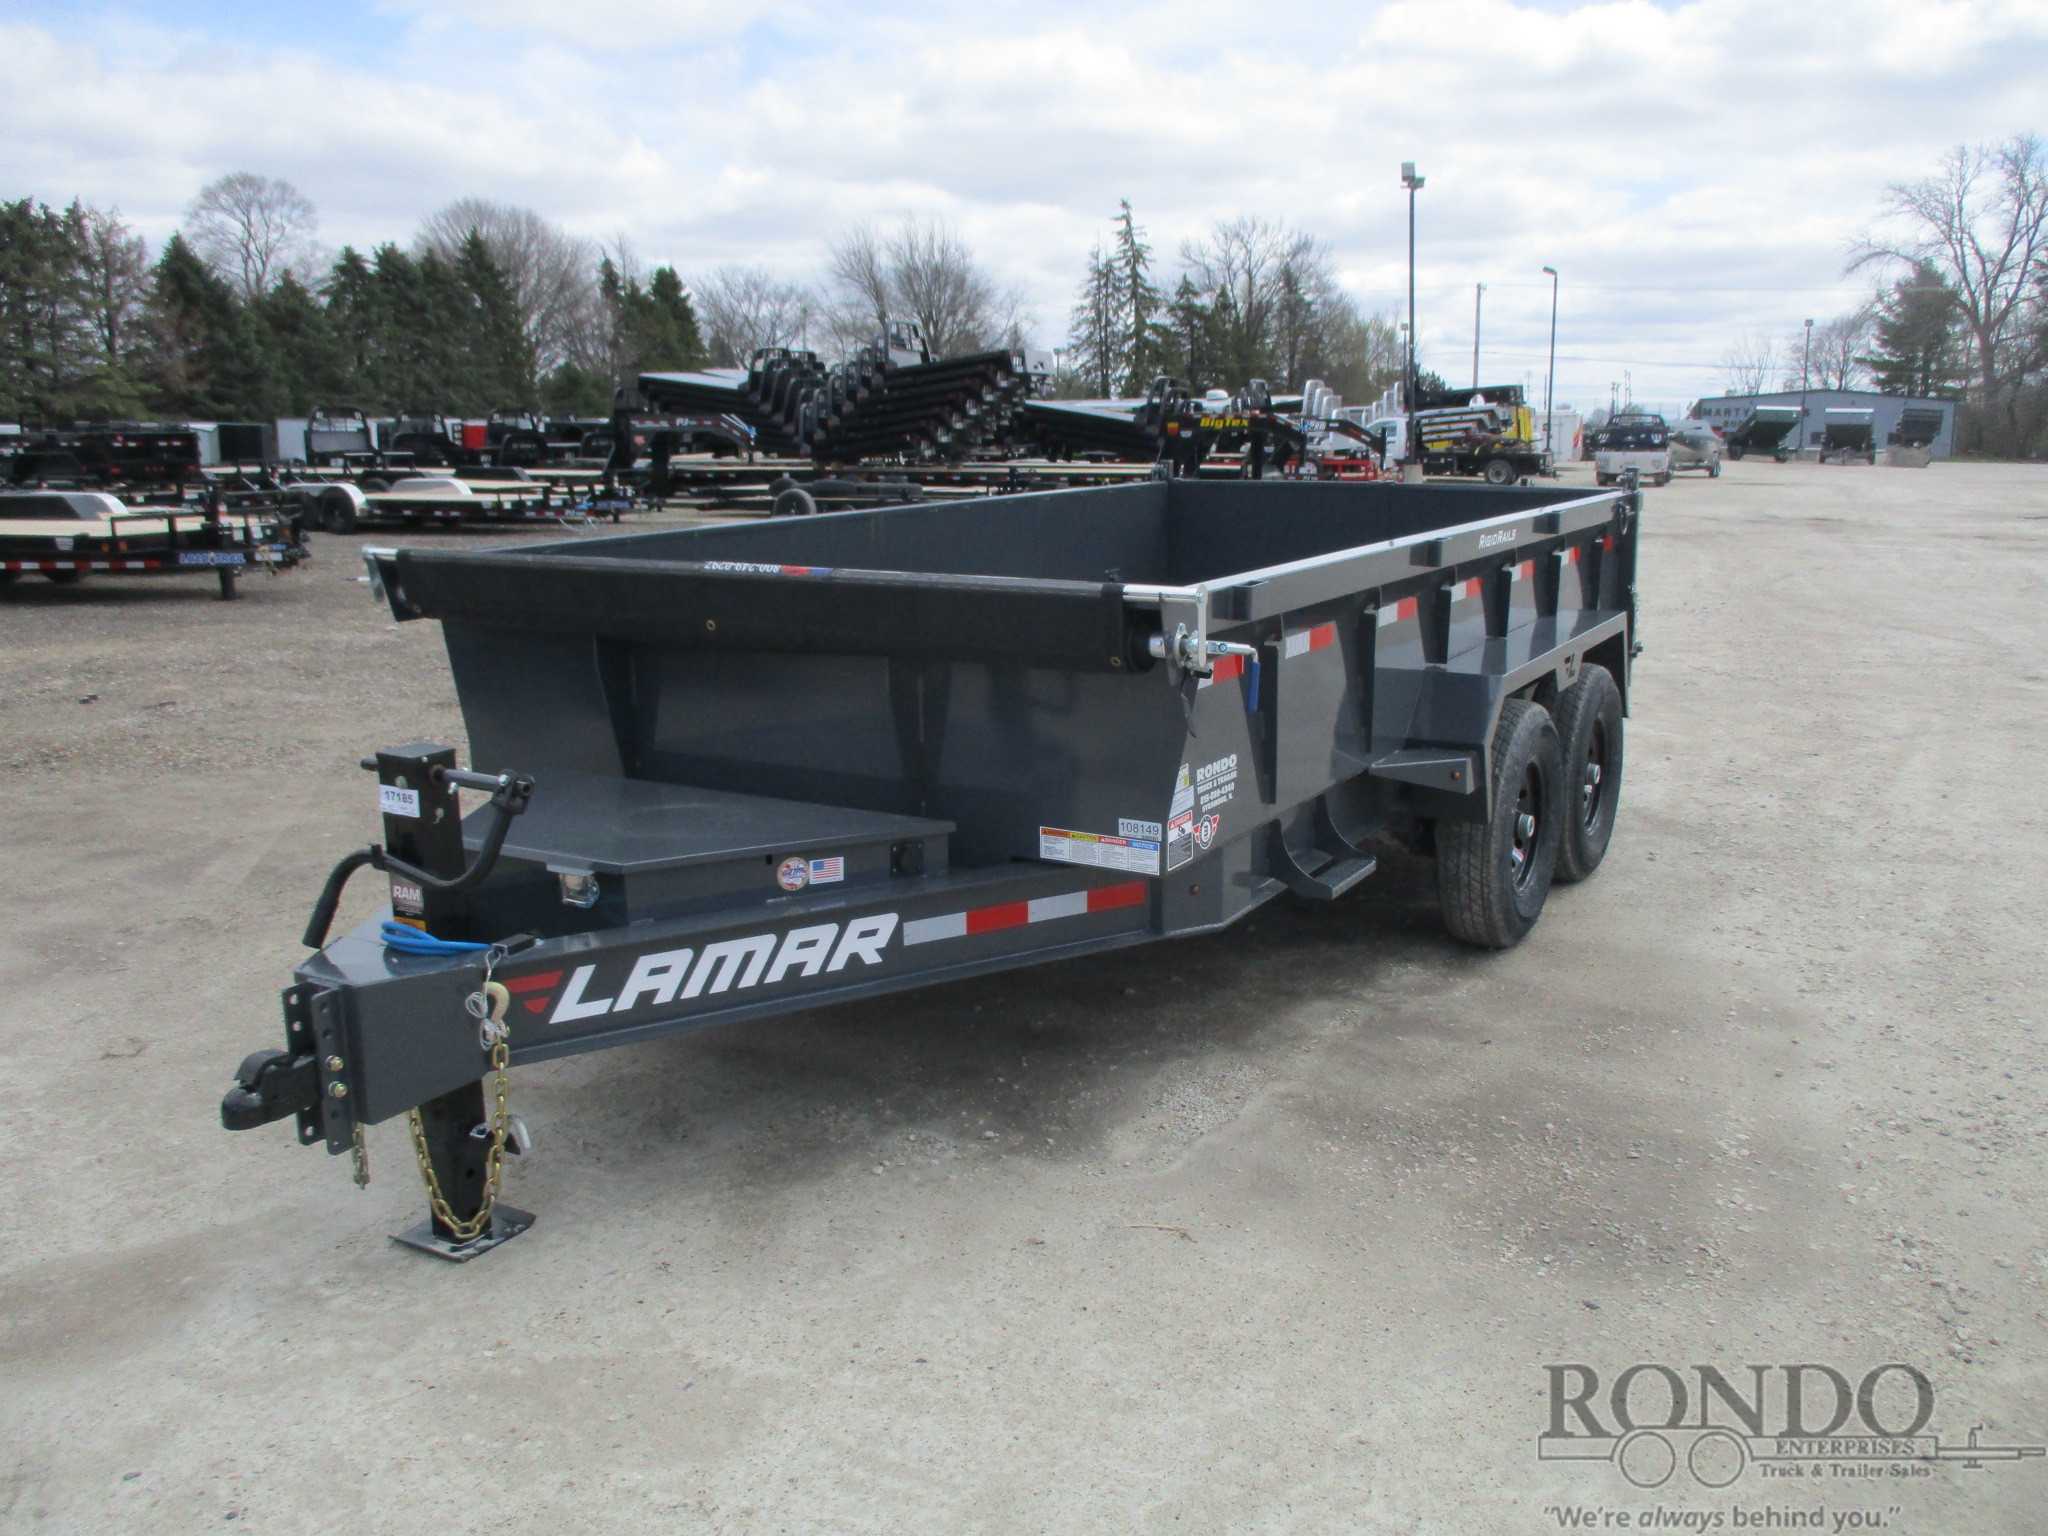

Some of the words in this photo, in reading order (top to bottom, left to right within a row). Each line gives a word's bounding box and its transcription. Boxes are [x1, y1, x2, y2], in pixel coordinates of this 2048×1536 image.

[1196, 753, 1238, 782] RONDO
[384, 790, 414, 805] 17185
[1120, 822, 1159, 836] 108149
[393, 885, 421, 902] RAM
[549, 912, 899, 1024] LAMAR
